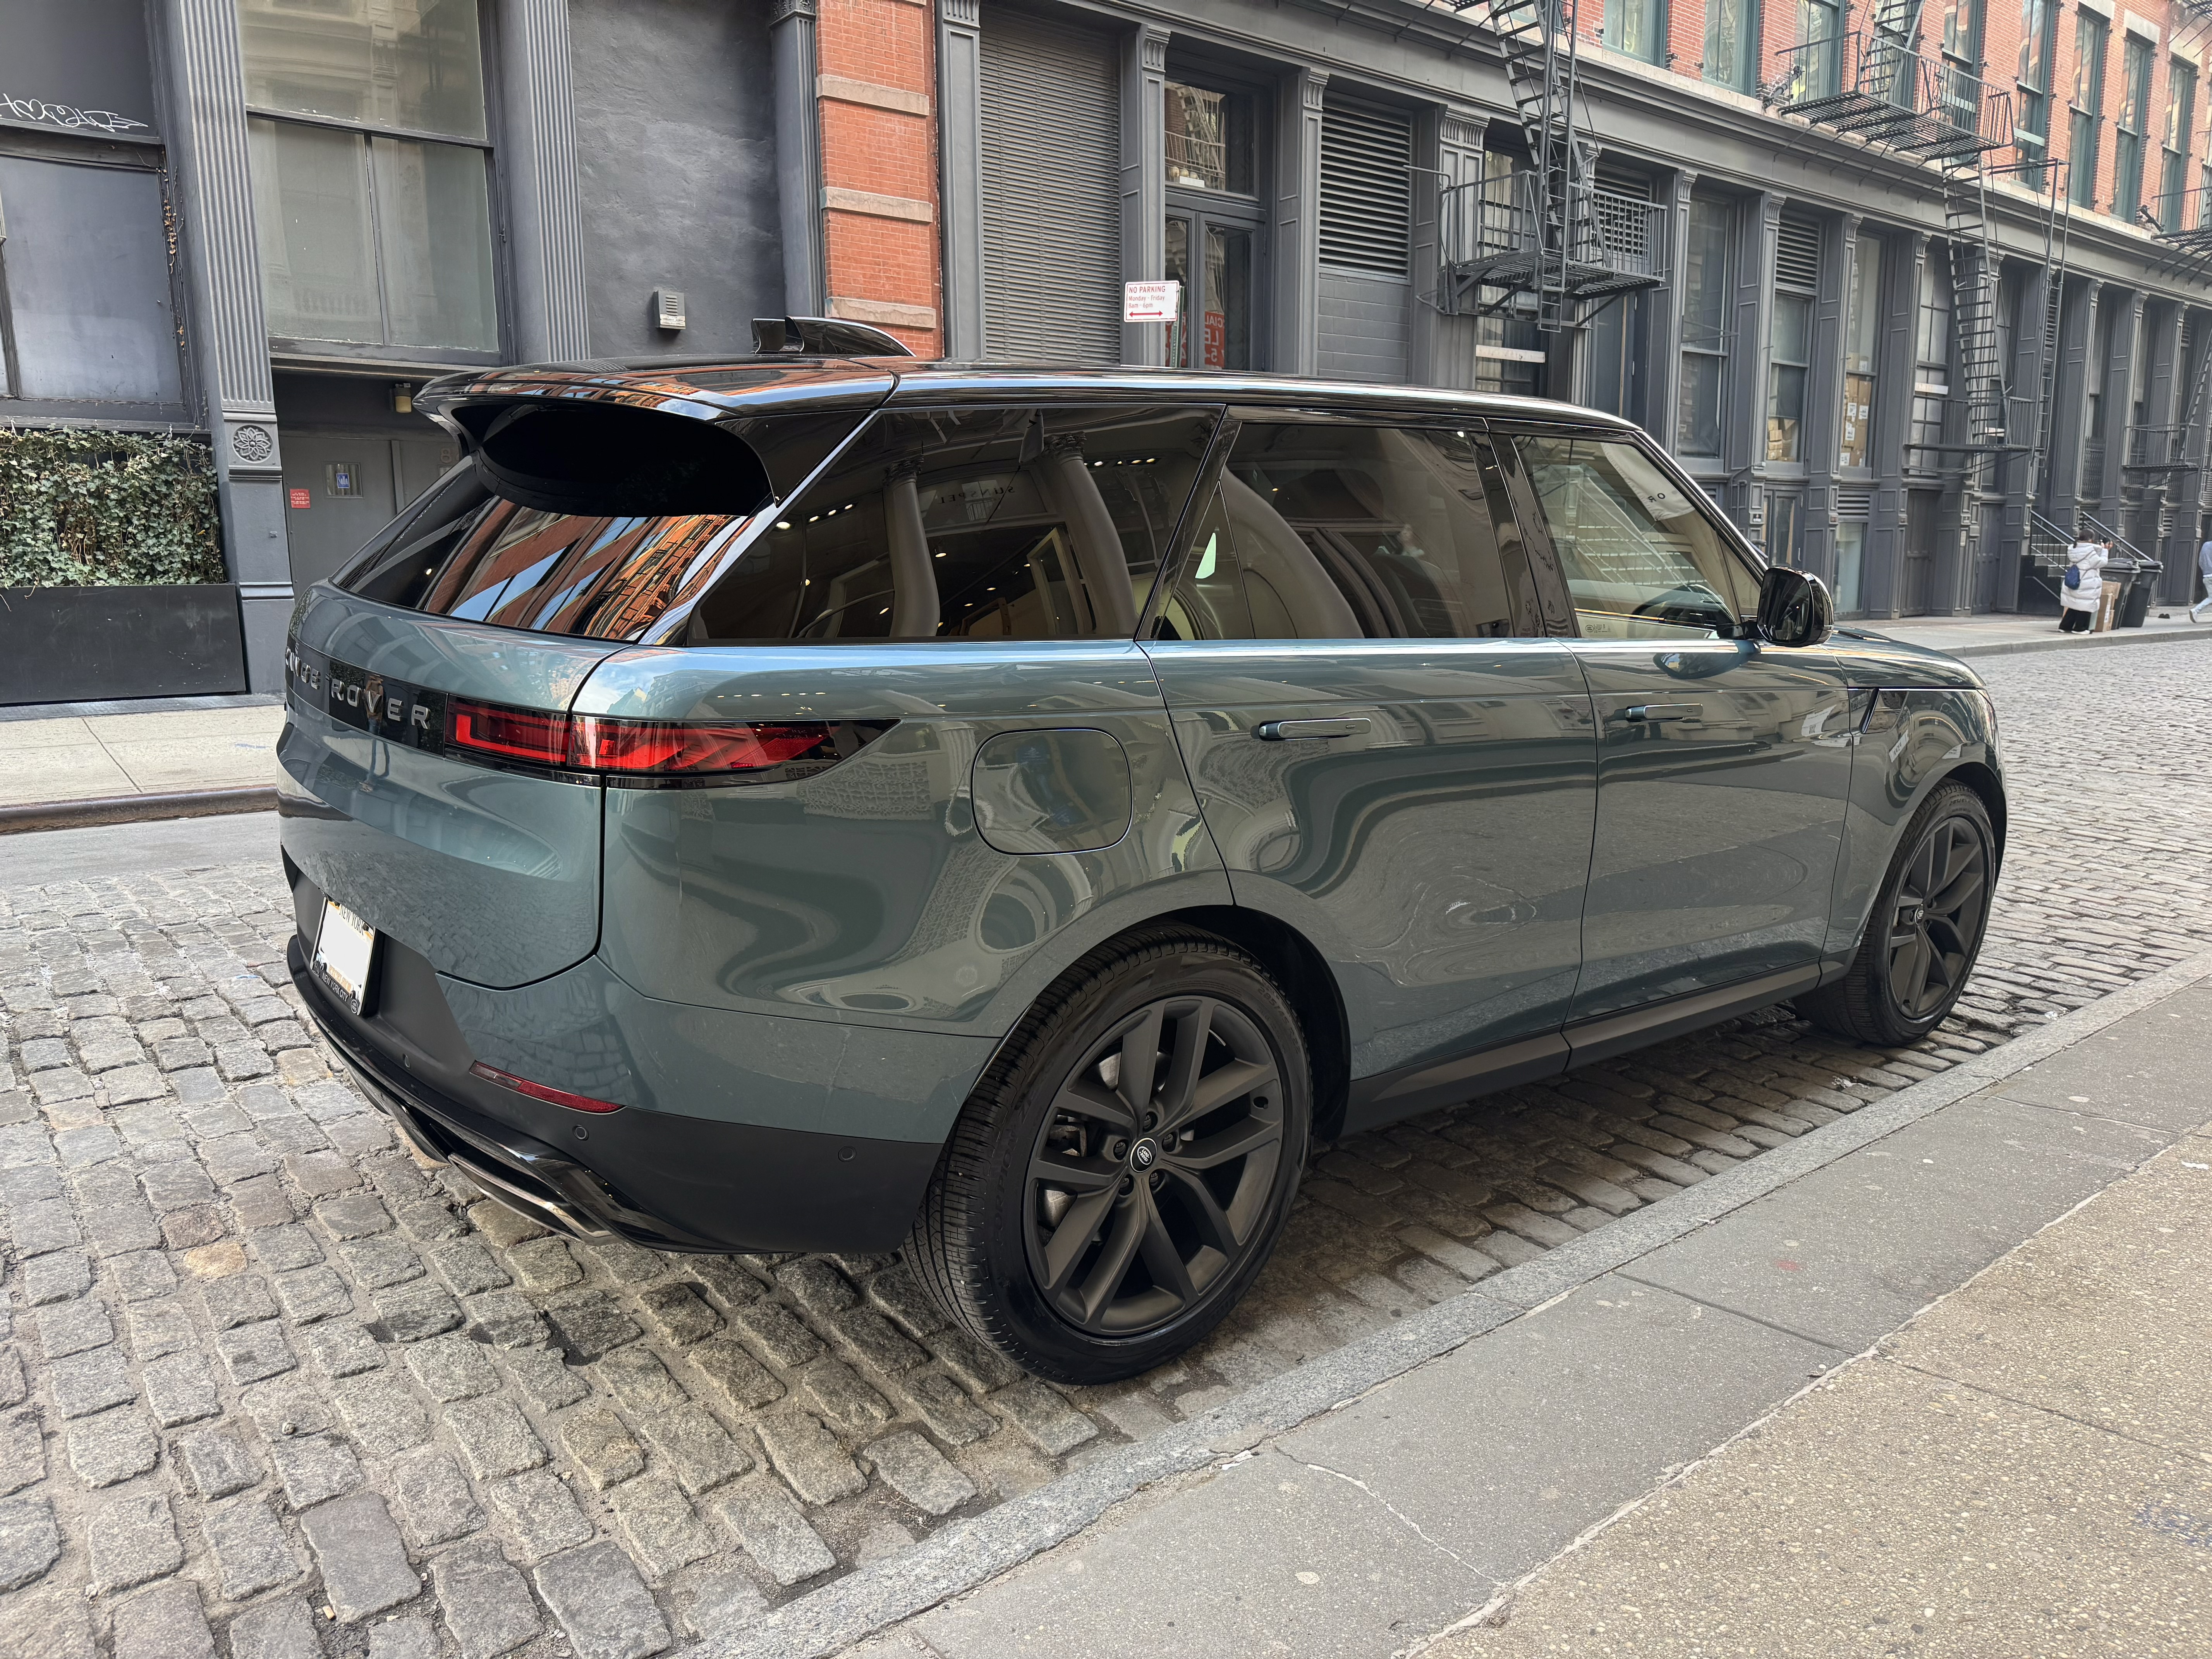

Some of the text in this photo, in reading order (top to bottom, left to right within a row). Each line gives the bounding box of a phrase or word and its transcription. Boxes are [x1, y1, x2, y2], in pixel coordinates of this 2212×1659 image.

[331, 678, 431, 730] ROVER
[339, 904, 364, 936] NEW YORK
[321, 972, 331, 986] NEW
[330, 980, 340, 995] YORK
[340, 989, 349, 1002] CITY
